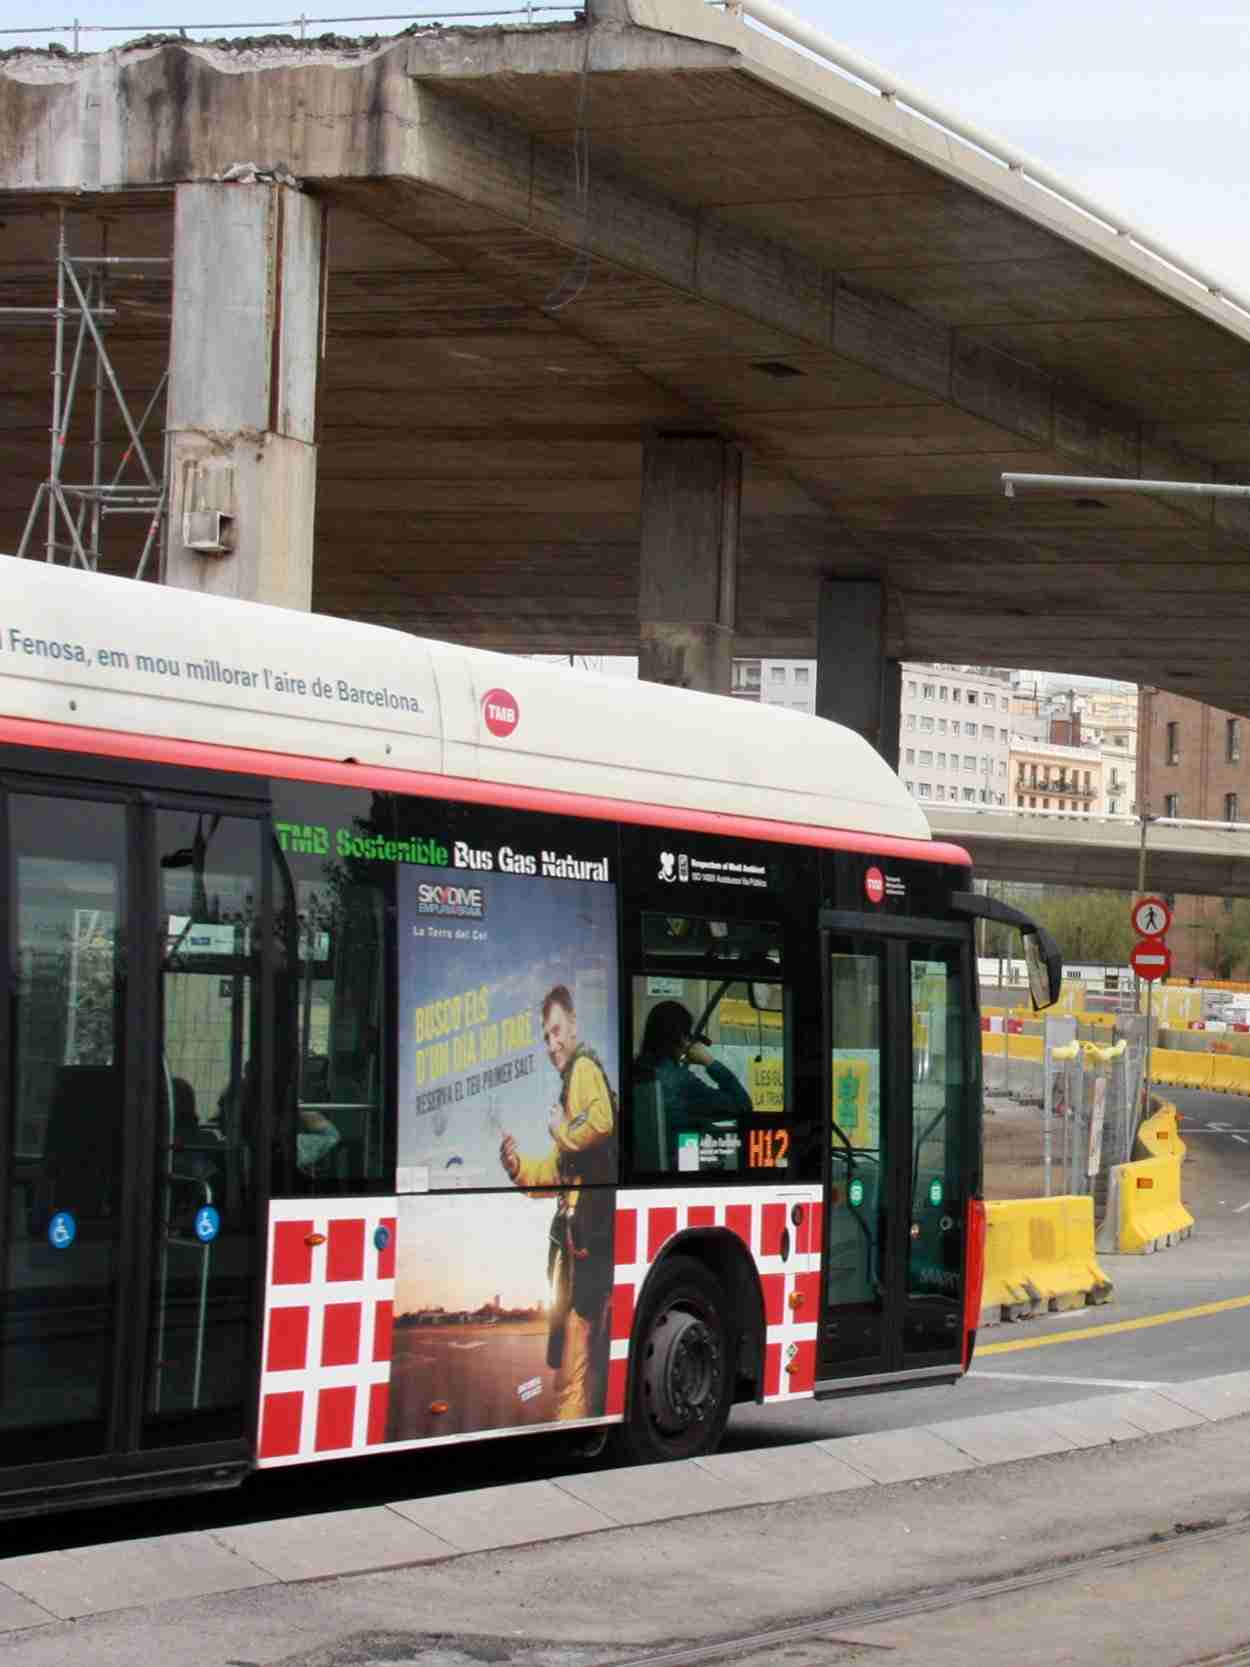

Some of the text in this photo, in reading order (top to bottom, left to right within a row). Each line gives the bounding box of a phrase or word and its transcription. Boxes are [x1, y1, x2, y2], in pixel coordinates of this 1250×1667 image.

[8, 629, 424, 713] Fenosa, em mou millorar l'aire de Barcelona.
[488, 703, 515, 723] TMB
[274, 823, 609, 882] TMB Sostenible Bus Gas Natural
[417, 883, 482, 907] SKYDIVE
[749, 1129, 790, 1168] H12
